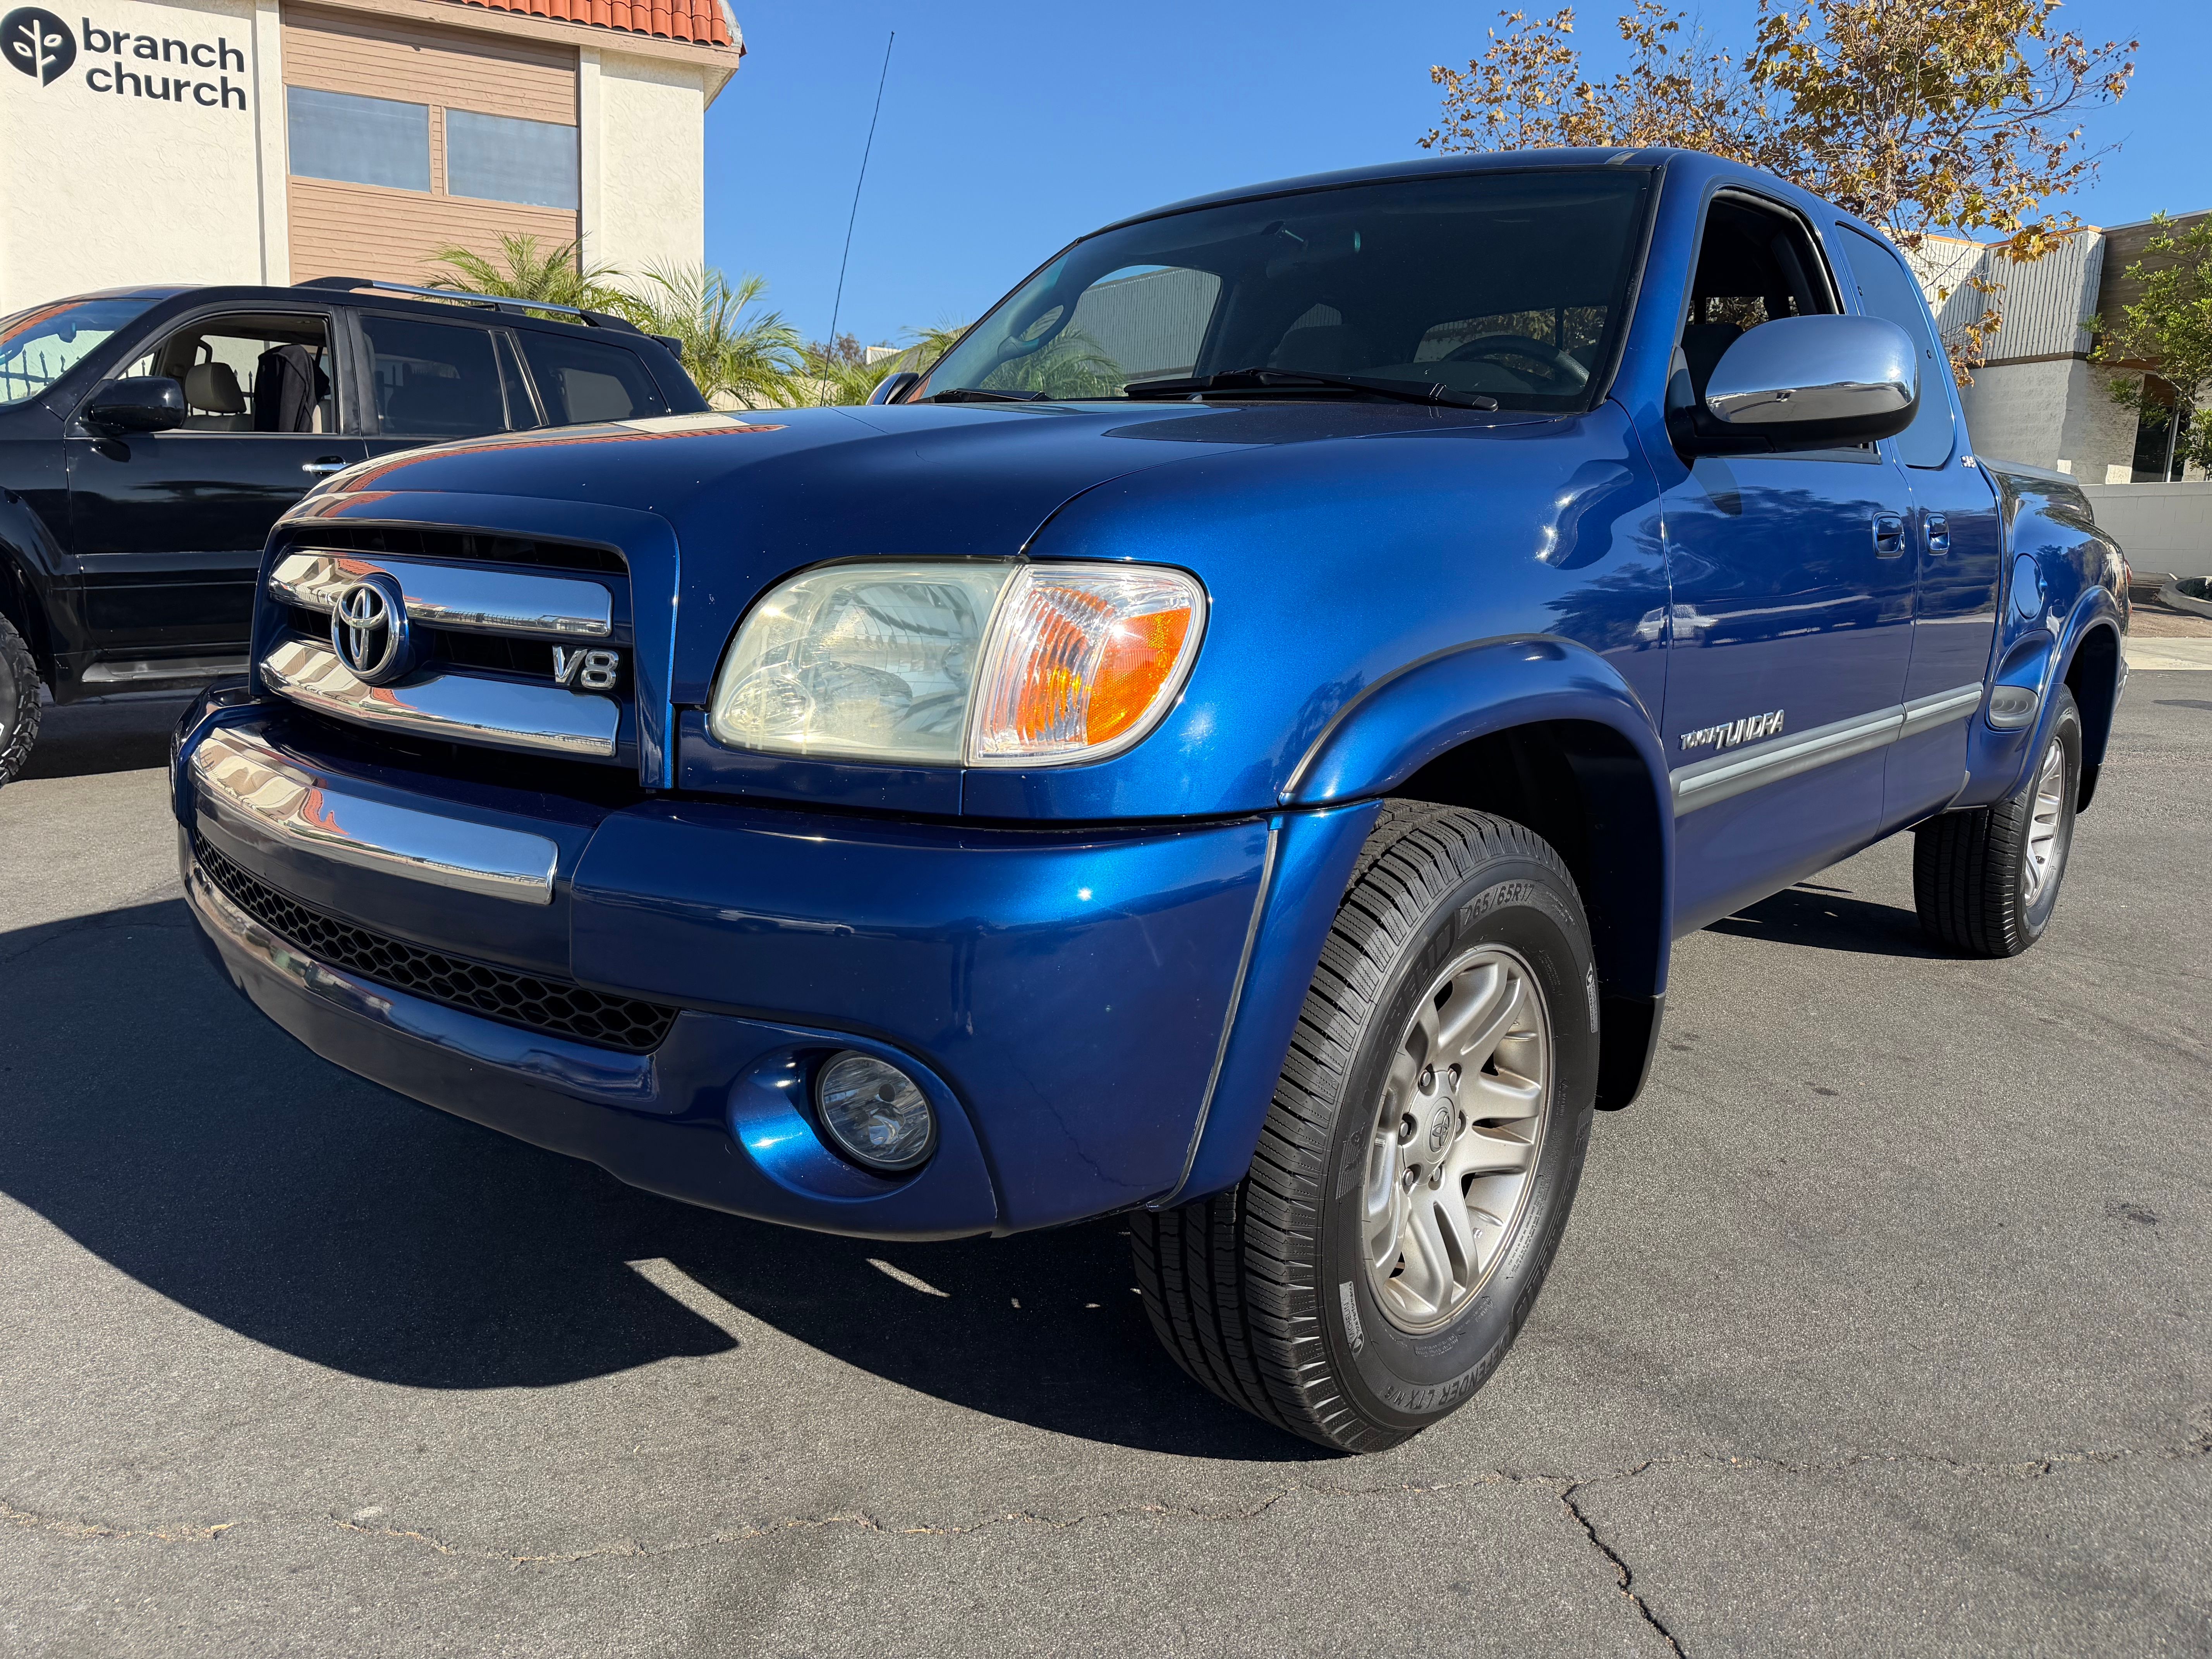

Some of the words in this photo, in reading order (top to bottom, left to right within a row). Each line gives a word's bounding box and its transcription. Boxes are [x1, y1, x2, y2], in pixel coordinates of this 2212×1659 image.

[82, 17, 244, 72] branch
[86, 62, 246, 111] church
[552, 646, 619, 690] V8
[1714, 709, 1784, 750] TUNDRA
[1464, 883, 1535, 925] 265/65R17
[1344, 1302, 1355, 1339] MICHELIN
[1384, 1385, 1405, 1406] M/S
[1404, 1389, 1435, 1409] LTX
